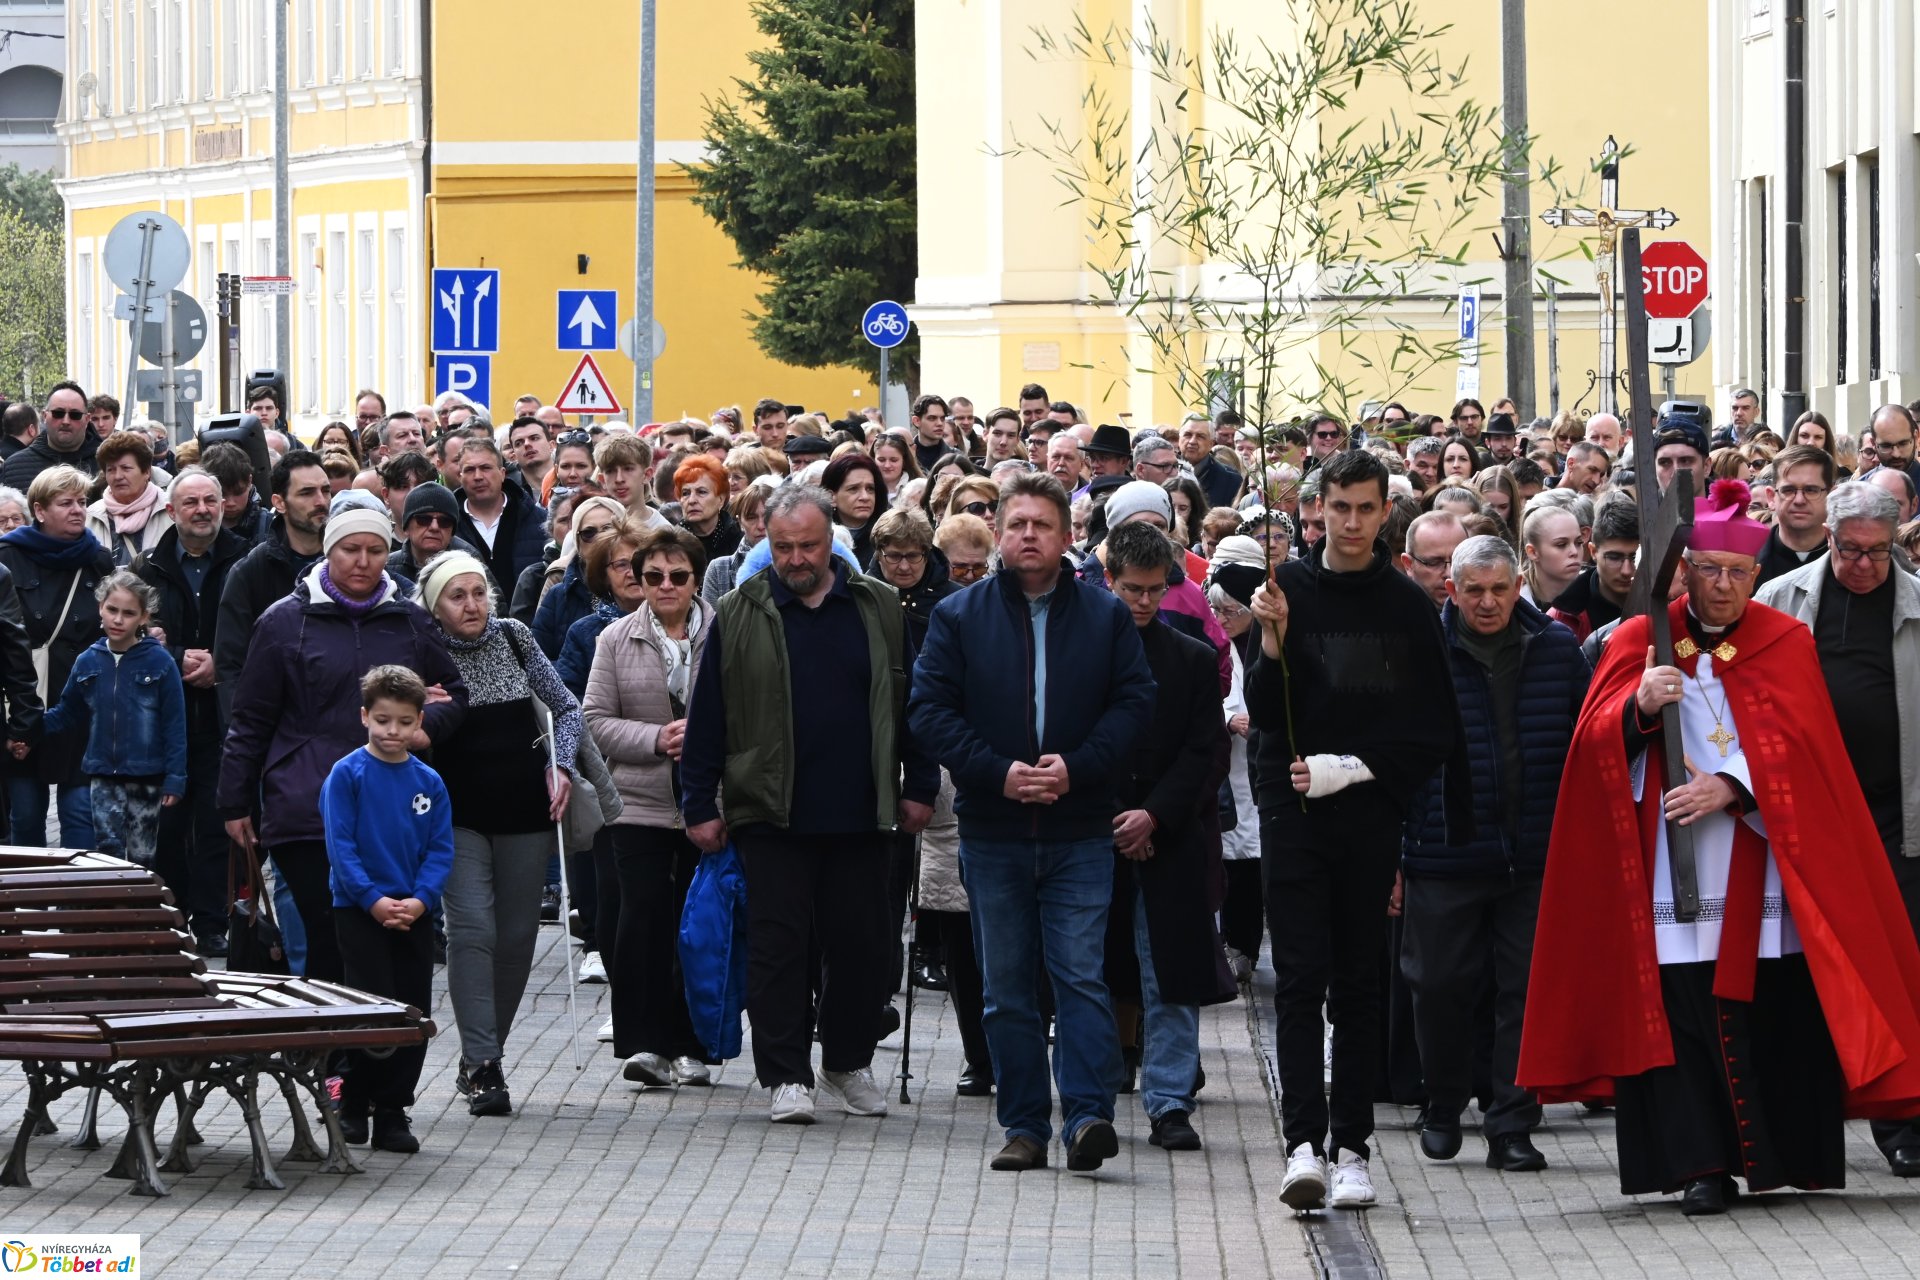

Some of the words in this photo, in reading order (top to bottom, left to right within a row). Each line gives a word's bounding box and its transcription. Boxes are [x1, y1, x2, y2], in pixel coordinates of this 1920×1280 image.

[1641, 266, 1703, 294] STOP
[1463, 301, 1473, 335] P
[448, 363, 477, 391] P
